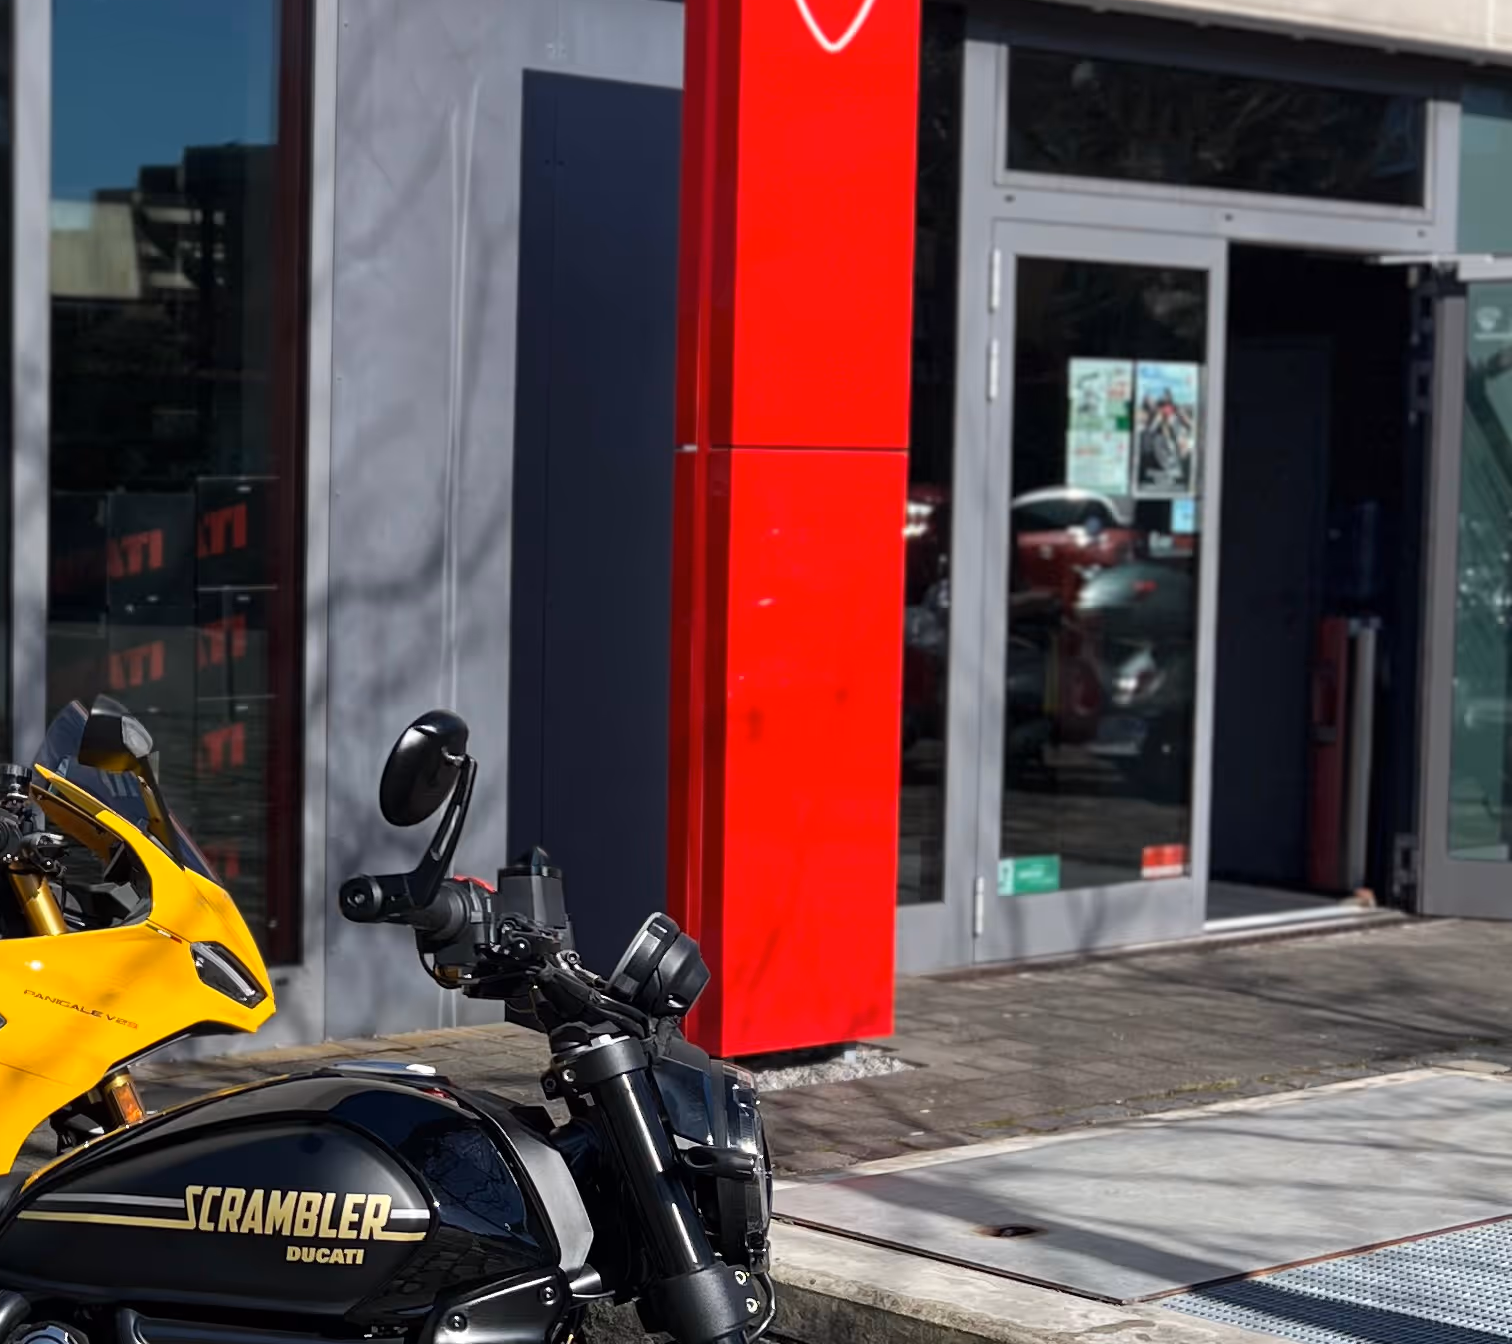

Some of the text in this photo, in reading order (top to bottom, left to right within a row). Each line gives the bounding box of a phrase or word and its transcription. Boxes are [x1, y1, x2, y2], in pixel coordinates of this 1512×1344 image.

[23, 988, 104, 1018] PANIGALE
[184, 1185, 393, 1241] SCRAMBLER
[286, 1245, 365, 1265] DUCATI
